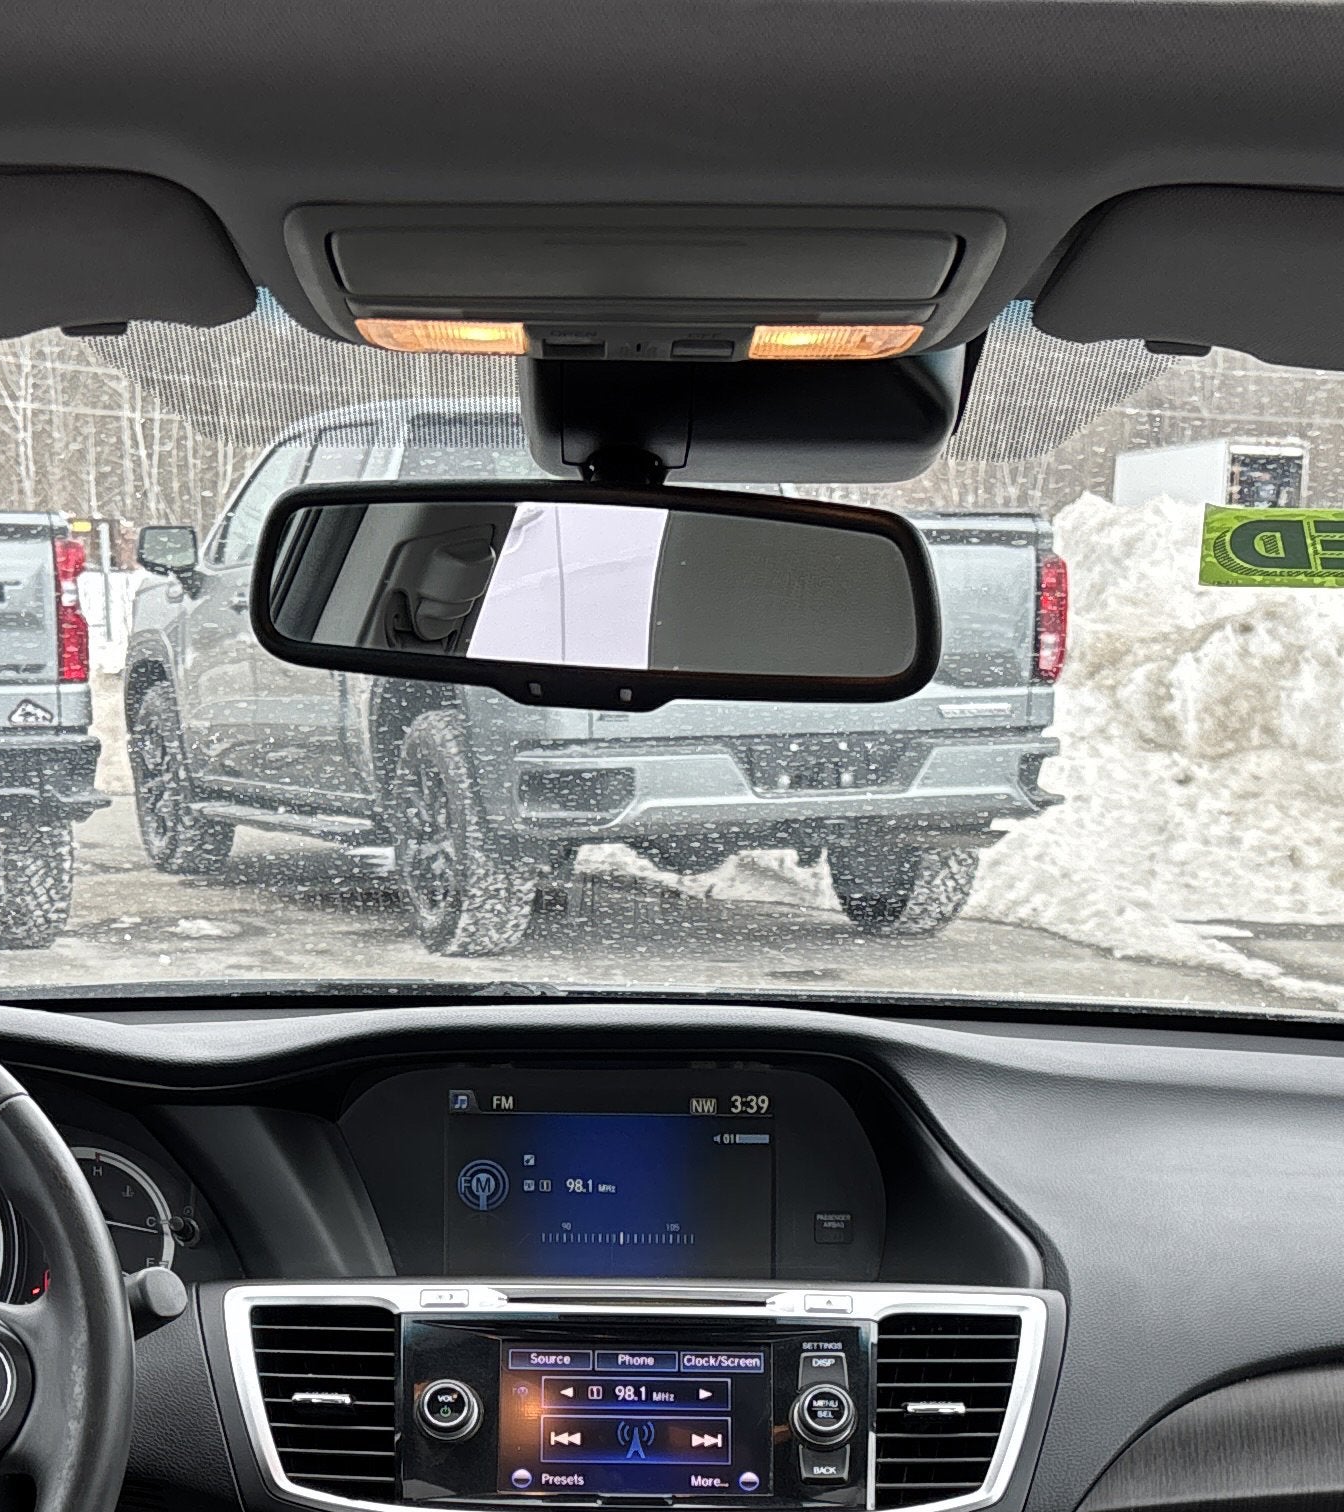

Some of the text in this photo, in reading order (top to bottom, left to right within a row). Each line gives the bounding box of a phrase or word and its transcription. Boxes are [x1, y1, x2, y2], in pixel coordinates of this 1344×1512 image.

[492, 1095, 514, 1110] FM
[692, 1099, 716, 1114] NW
[730, 1095, 769, 1114] 3:39
[92, 1166, 103, 1177] H
[565, 1179, 593, 1193] 98.1
[145, 1216, 156, 1227] C
[802, 1342, 843, 1350] SETTINGS
[530, 1353, 571, 1365] Source
[617, 1354, 655, 1366] Phone
[683, 1355, 760, 1367] Clock/Screen
[812, 1358, 836, 1367] DISP
[437, 1394, 454, 1403] VOL
[615, 1385, 646, 1401] 98.1
[652, 1392, 675, 1402] MHz
[812, 1400, 838, 1408] MENU
[816, 1410, 834, 1418] SEL
[813, 1466, 837, 1475] BACK
[541, 1473, 584, 1486] Presets
